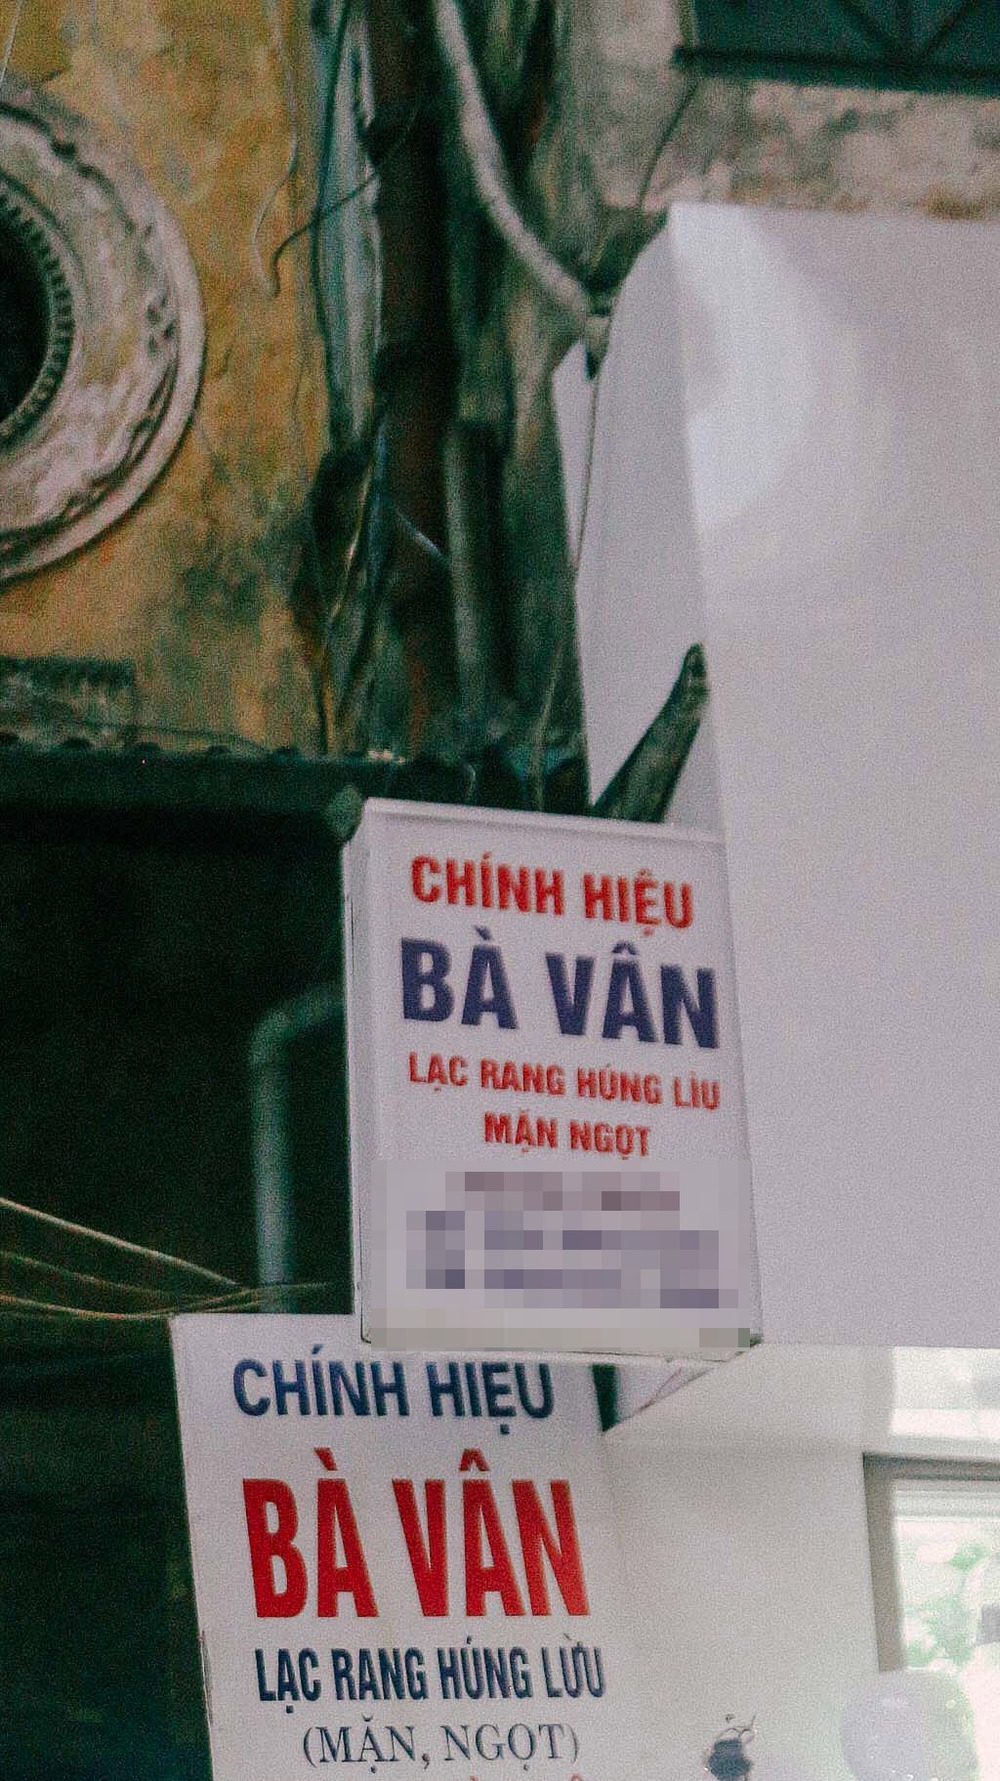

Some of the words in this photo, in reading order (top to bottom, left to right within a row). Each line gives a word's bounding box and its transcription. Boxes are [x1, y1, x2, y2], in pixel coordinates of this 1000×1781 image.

[411, 851, 563, 916] CHÍNH
[583, 868, 693, 936] HIỆU
[400, 926, 518, 1030] BÀ
[546, 943, 719, 1049] VÂN
[408, 1050, 468, 1091] LẠC
[480, 1060, 564, 1095] RANG
[569, 1119, 651, 1160] NGỌT
[233, 1345, 409, 1417] CHÍNH
[244, 1449, 377, 1617] BÀ
[394, 1451, 588, 1616] VÂN
[255, 1648, 321, 1714] LẠC
[331, 1648, 428, 1700] RANG
[303, 1717, 429, 1773] (MẶN,
[444, 1723, 580, 1772] NGỌT)
